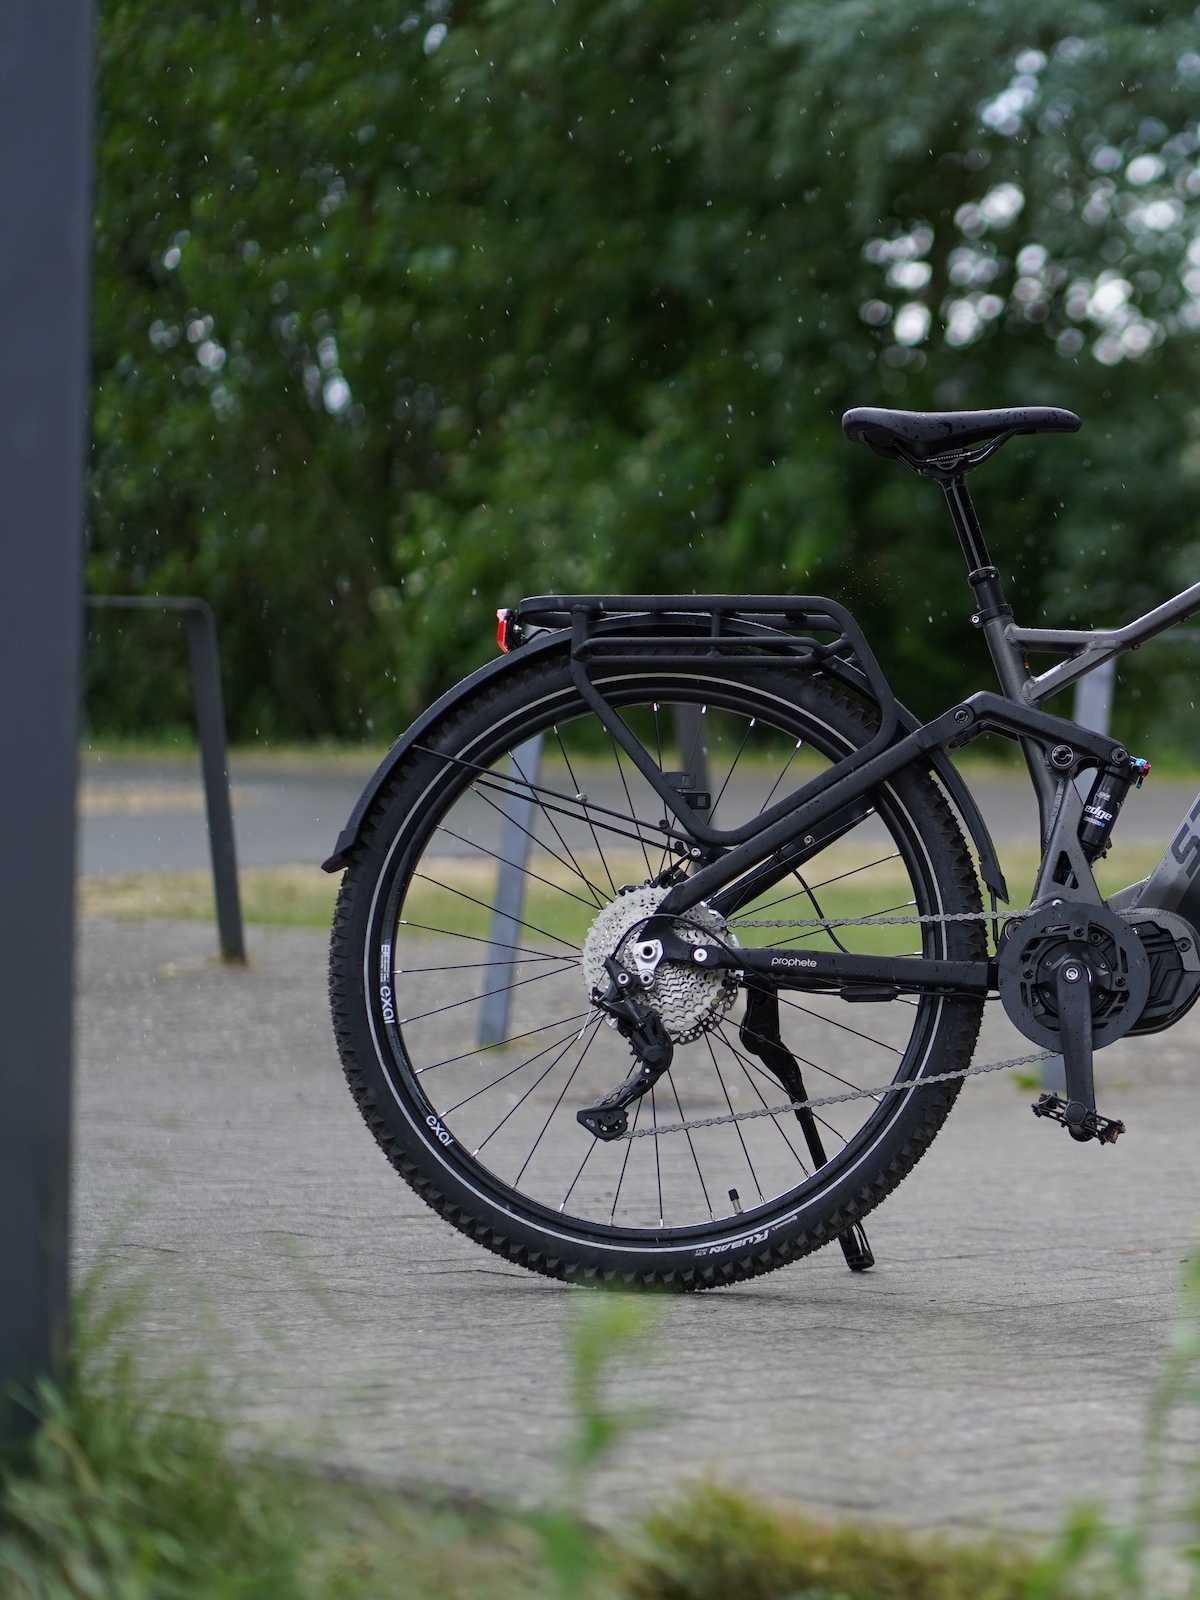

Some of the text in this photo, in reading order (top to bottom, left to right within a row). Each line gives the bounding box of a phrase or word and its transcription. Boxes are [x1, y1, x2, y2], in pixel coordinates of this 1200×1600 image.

[1084, 805, 1113, 821] edge
[771, 957, 817, 967] prophete
[380, 985, 395, 1024] exal
[425, 1115, 454, 1147] exal
[708, 1229, 769, 1255] RUBAN
